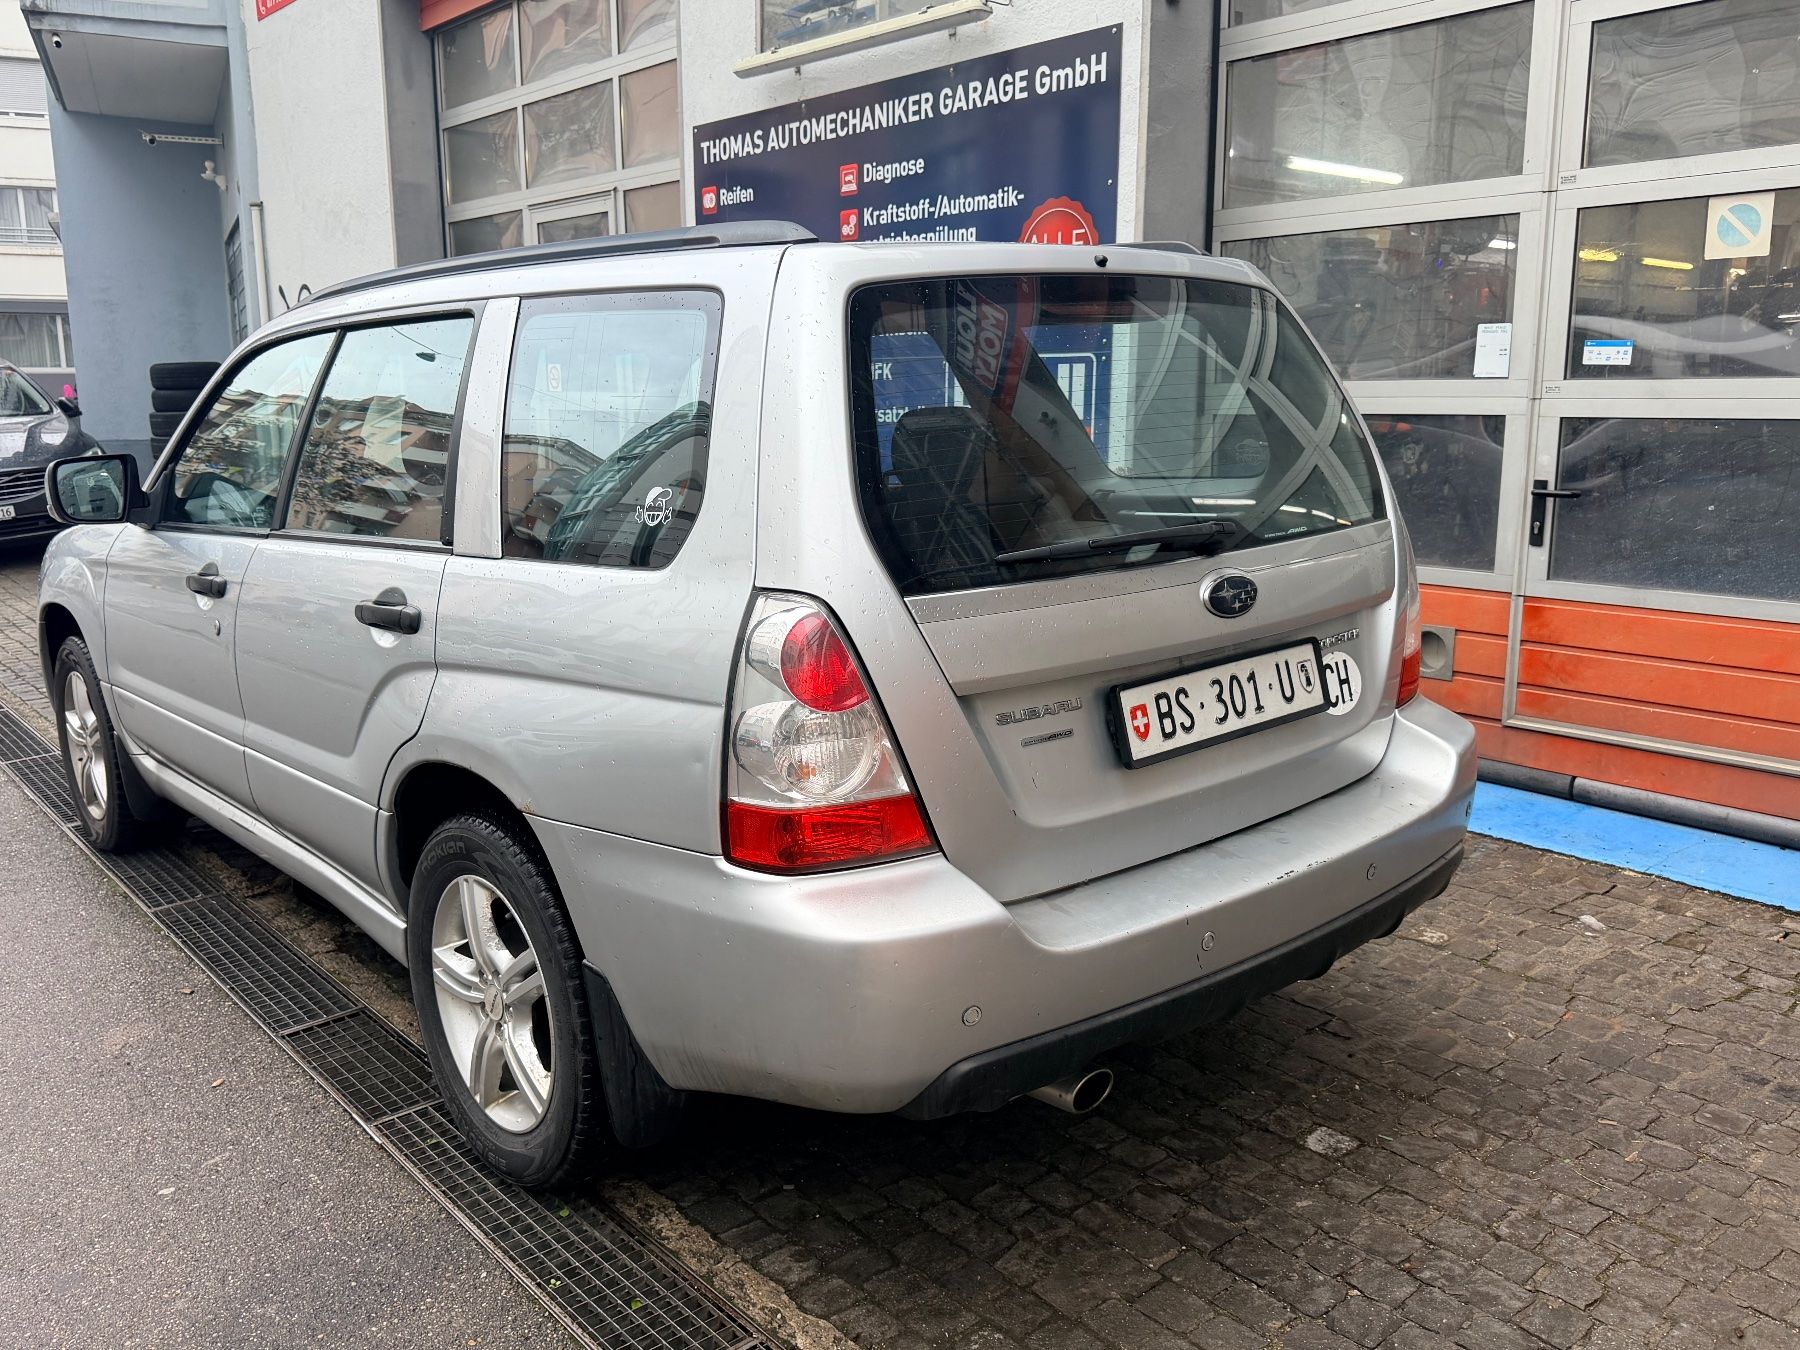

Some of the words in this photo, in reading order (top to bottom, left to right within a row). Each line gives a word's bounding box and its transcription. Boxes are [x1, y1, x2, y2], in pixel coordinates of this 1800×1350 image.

[700, 129, 764, 165] THOMAS
[766, 92, 934, 152] AUTOMECHANIKER
[938, 69, 1028, 116] GARAGE
[1034, 51, 1108, 96] GmbH
[863, 157, 925, 184] Diagnose
[719, 186, 754, 206] Reifen
[863, 186, 1025, 227] Kraftstoff-/Automatik-
[865, 225, 977, 242] bespülung
[872, 362, 893, 381] FK
[1319, 628, 1360, 648] ORESTER
[1324, 659, 1353, 708] CH
[995, 698, 1083, 726] SUBARU
